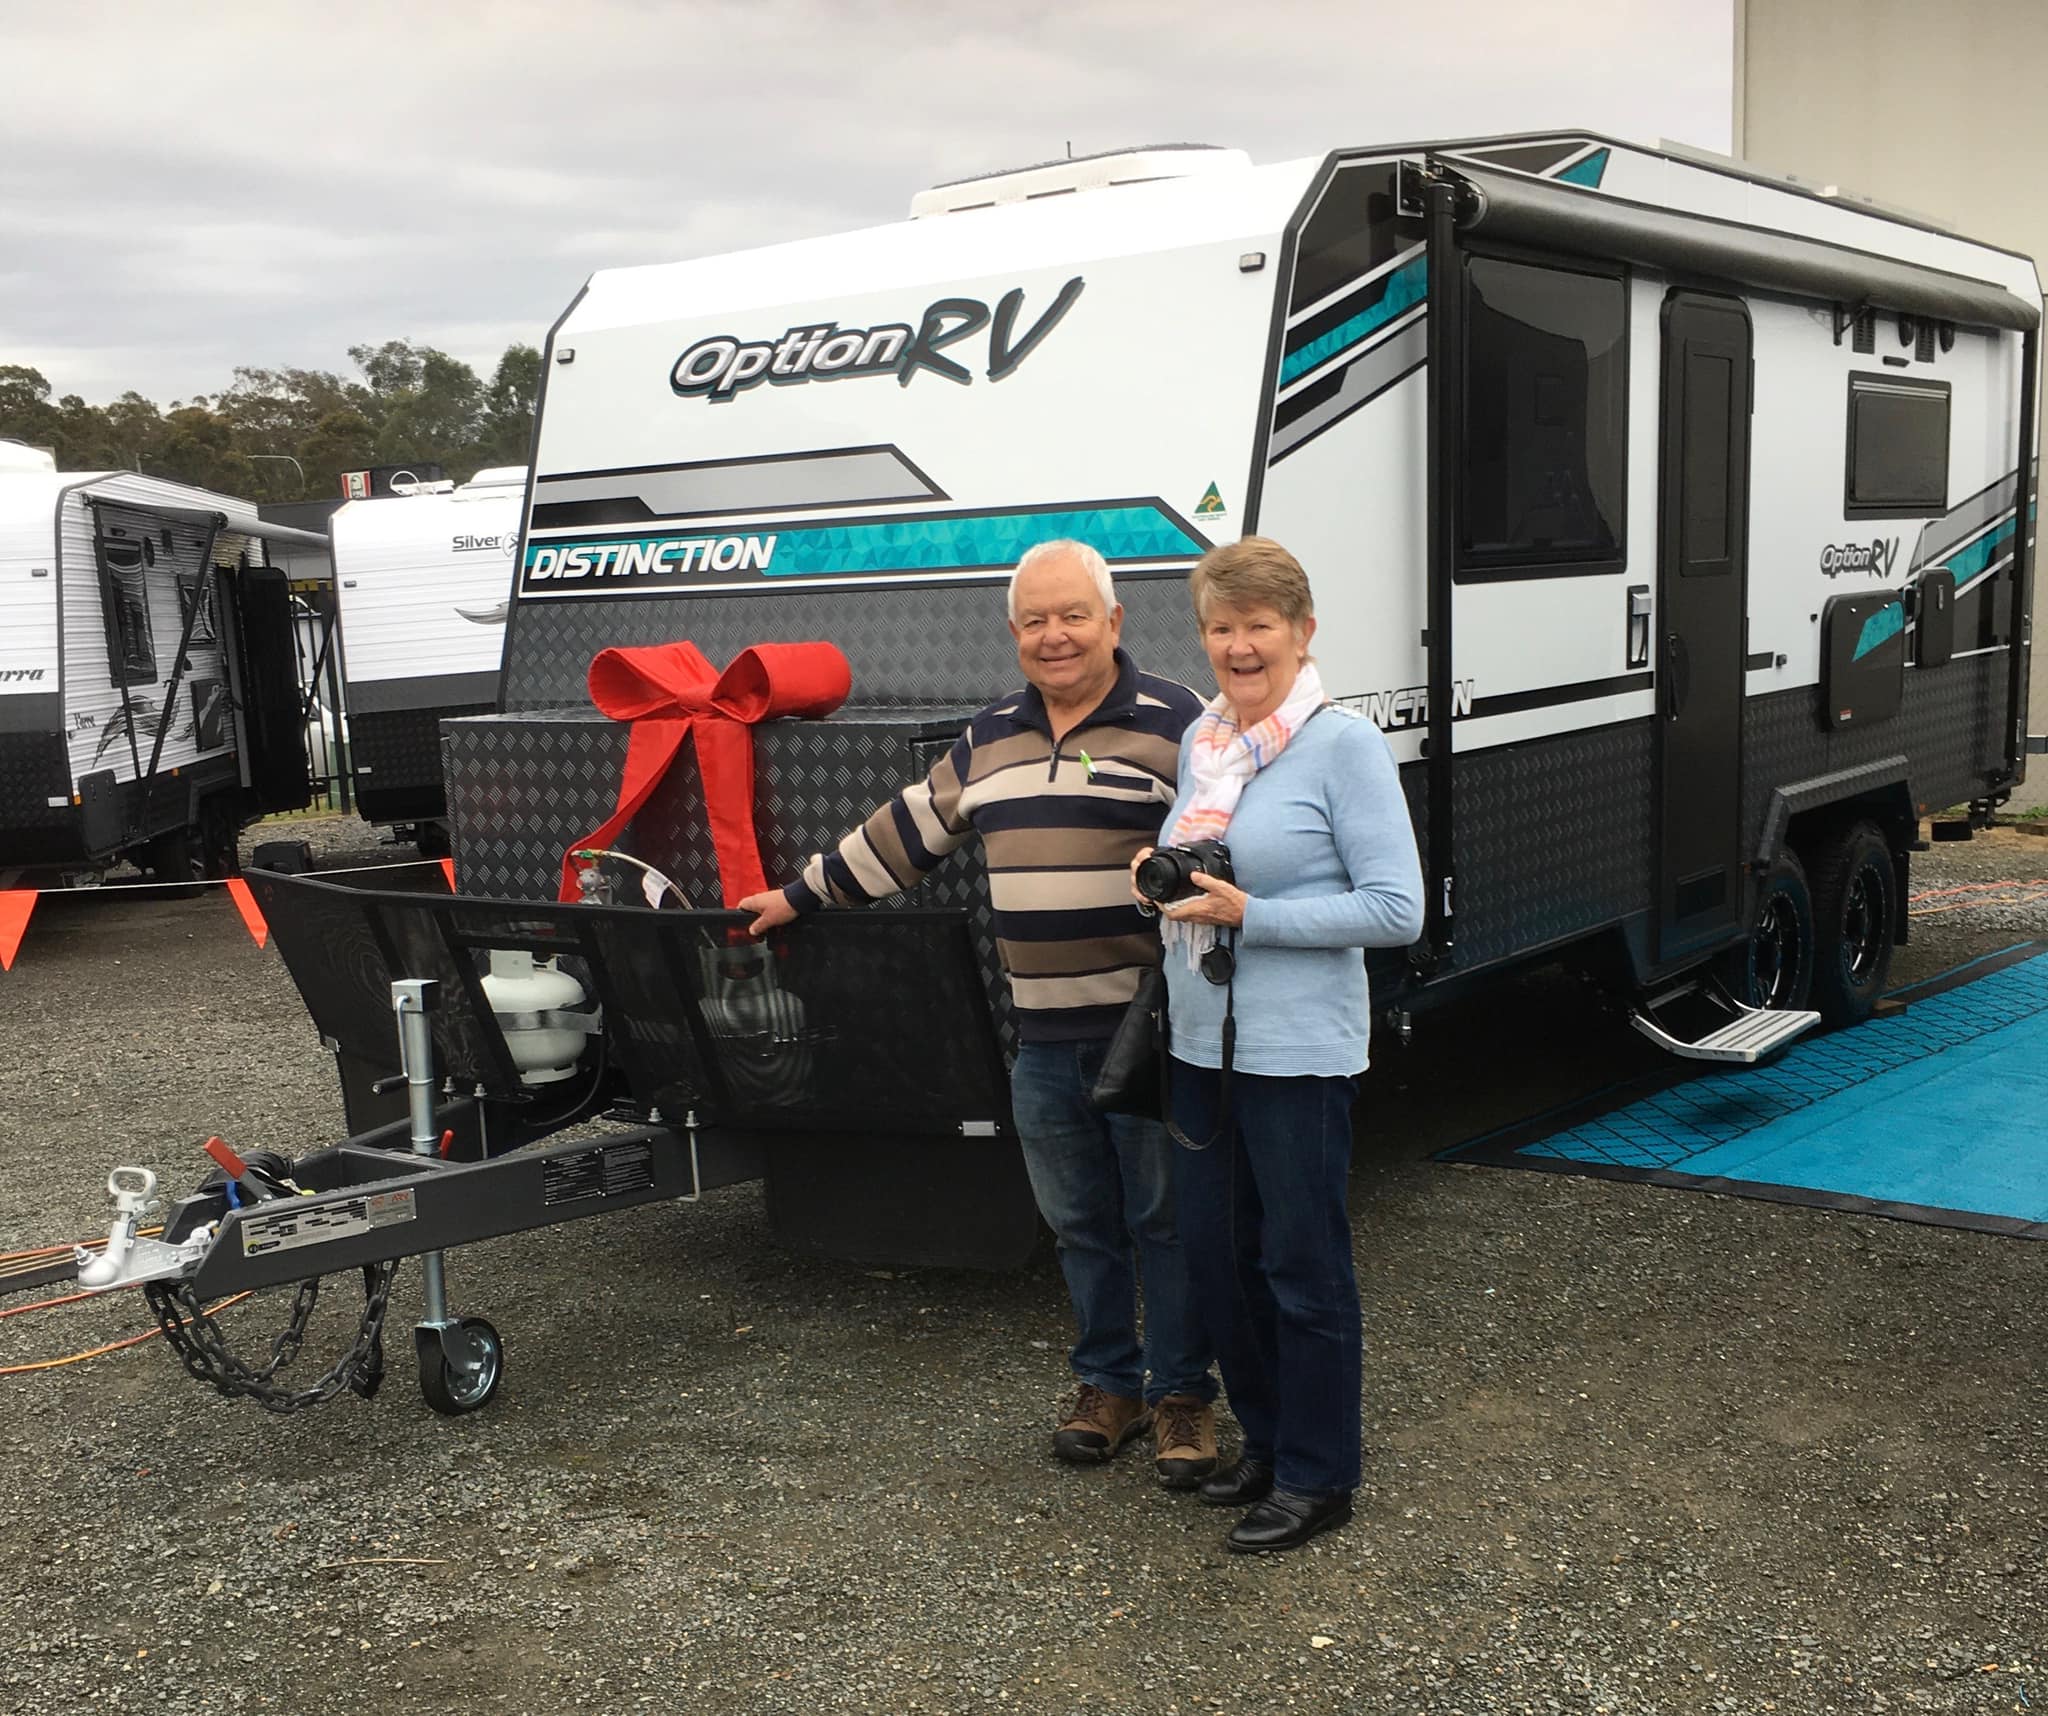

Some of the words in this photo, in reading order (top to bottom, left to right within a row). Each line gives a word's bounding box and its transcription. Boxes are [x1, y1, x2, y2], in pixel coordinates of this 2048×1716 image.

[453, 535, 502, 549] Silver
[529, 535, 778, 581] DISTINCTION
[0, 669, 45, 682] rra
